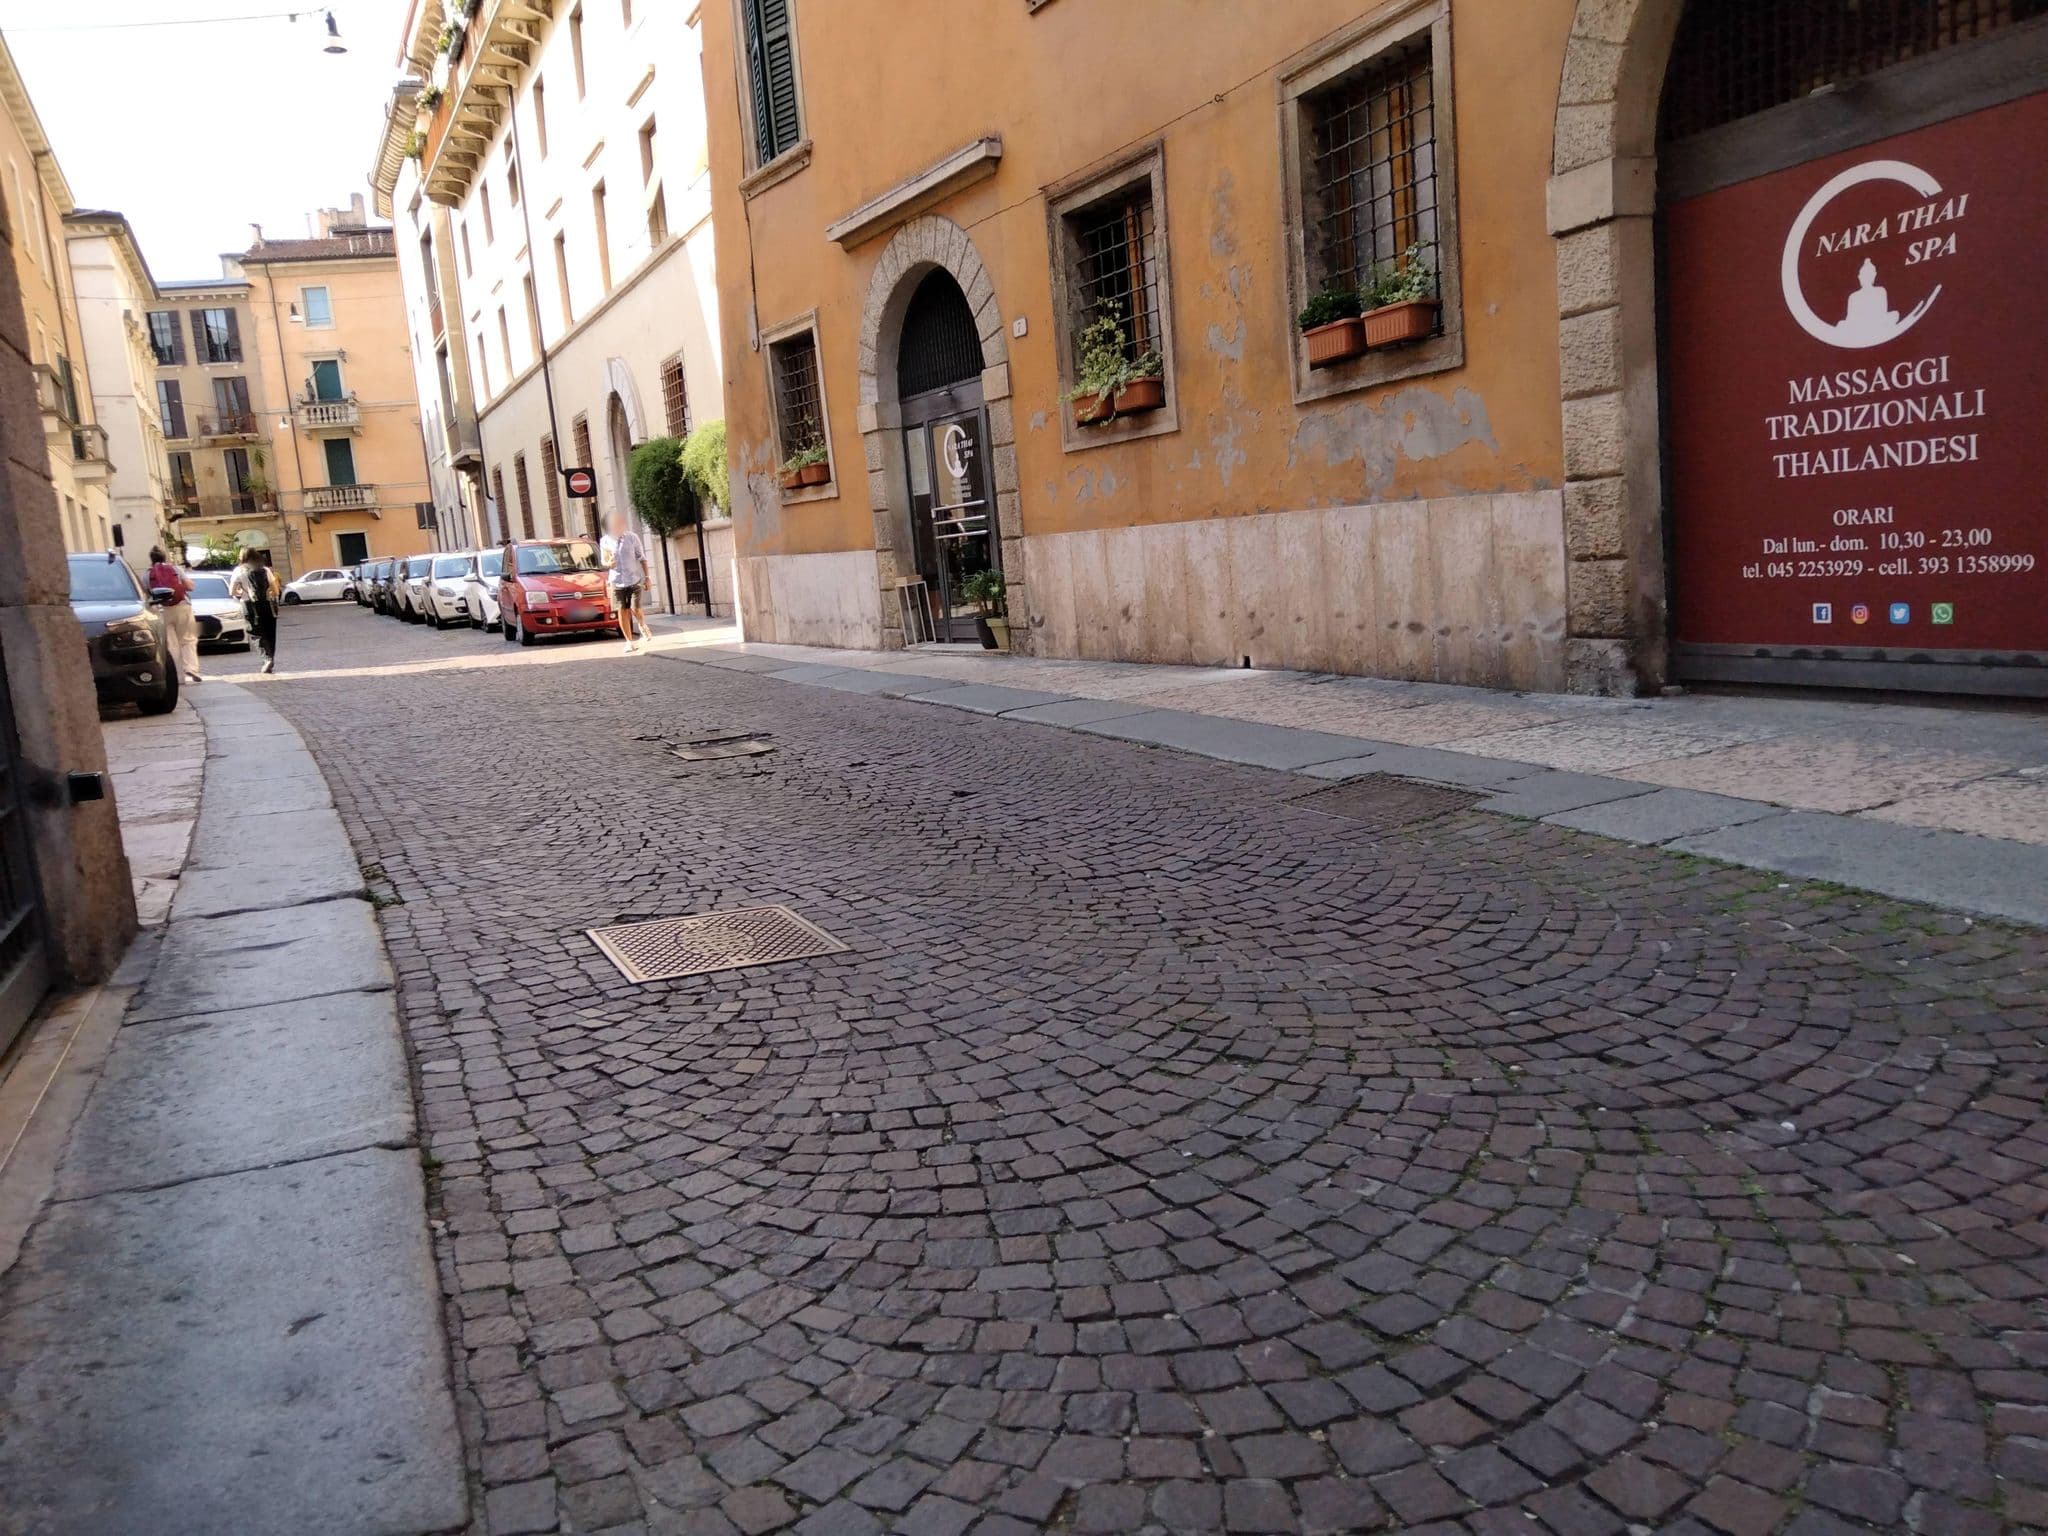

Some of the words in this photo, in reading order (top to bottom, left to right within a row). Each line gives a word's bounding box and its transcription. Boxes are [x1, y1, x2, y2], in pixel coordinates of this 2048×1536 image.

[1815, 217, 1888, 257] NARA
[1897, 193, 1969, 234] THAI
[1904, 231, 1957, 266] SPA
[1788, 355, 1950, 404] MASSAGGI
[1765, 388, 1986, 441] TRADIZIONALI
[1772, 433, 1979, 479] THAILANDESI
[1833, 506, 1894, 526] ORARI
[1762, 537, 1788, 554] Dal
[1829, 534, 1869, 551] dom.
[1879, 530, 1924, 552] 10,30
[1941, 528, 1992, 549] 23,00
[1742, 562, 1764, 578] tel.
[1767, 561, 1793, 578] 045
[1797, 559, 1863, 577] 2253929
[1878, 558, 1913, 576] cell.
[1918, 557, 1949, 575] 393
[1956, 553, 2036, 575] 1358999
